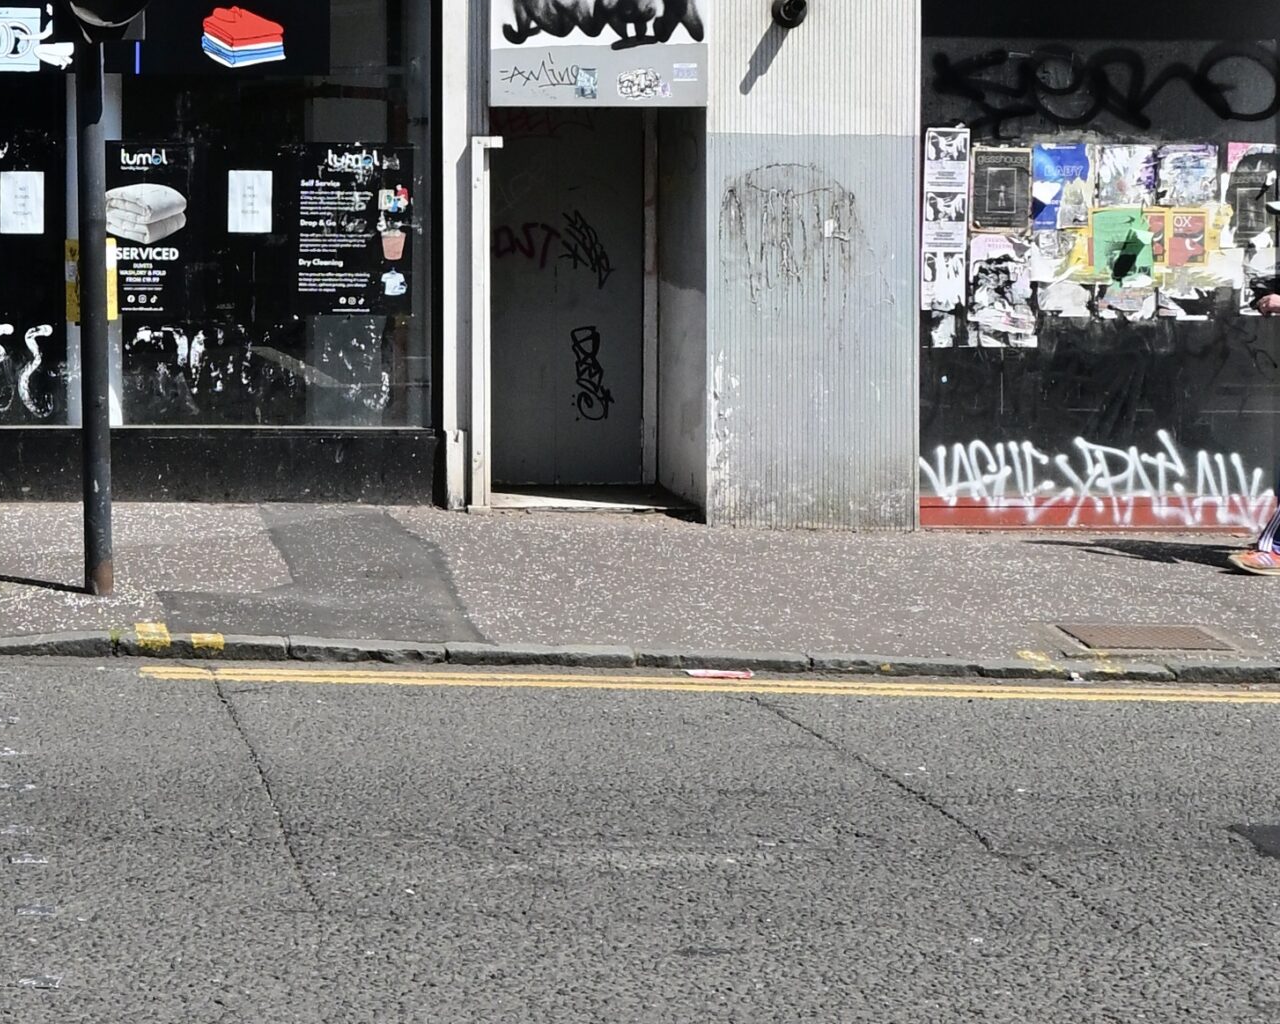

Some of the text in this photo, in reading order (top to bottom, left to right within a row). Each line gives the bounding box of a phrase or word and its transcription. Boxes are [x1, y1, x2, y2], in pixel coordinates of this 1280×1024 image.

[120, 148, 168, 165] tumbl
[300, 219, 318, 227] Drop
[326, 219, 337, 227] Go
[116, 247, 180, 261] SERVICED
[298, 258, 344, 268] Dry Cleaning
